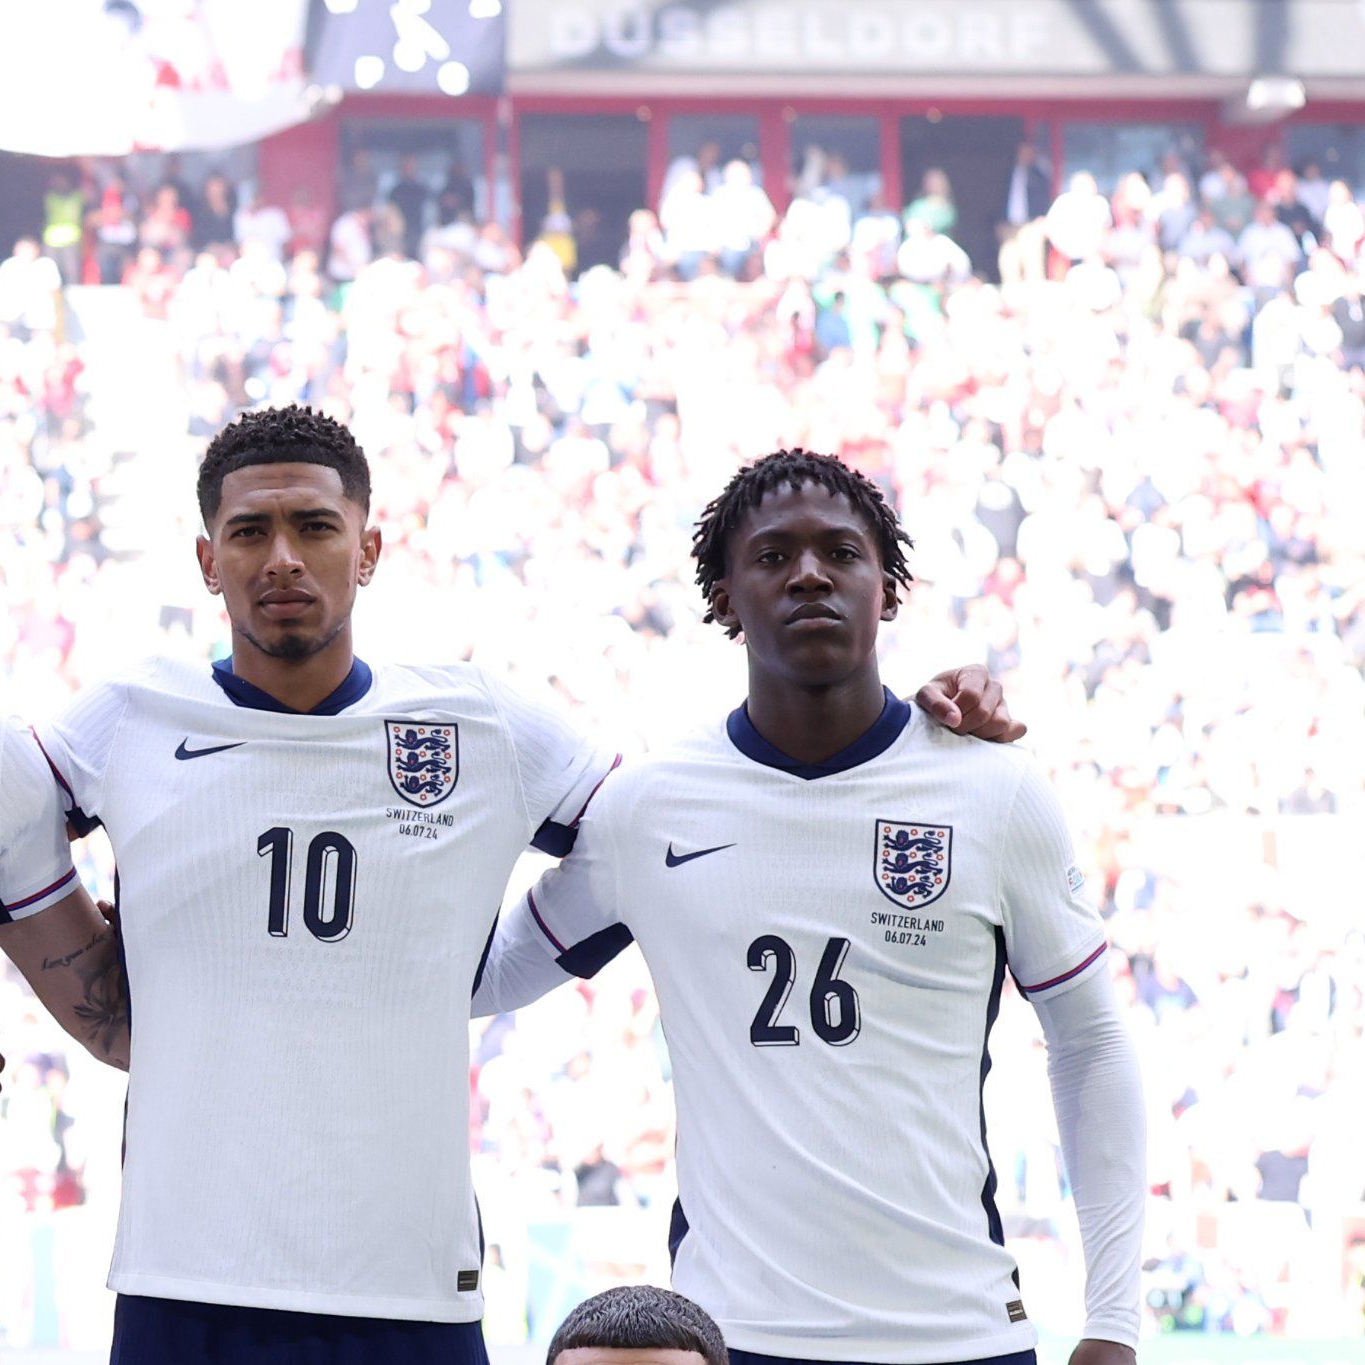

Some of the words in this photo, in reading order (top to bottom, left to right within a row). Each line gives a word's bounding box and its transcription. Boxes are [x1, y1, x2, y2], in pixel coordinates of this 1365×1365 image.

[386, 808, 454, 826] SWITZERLAND
[399, 824, 438, 840] 06.07.24
[256, 827, 358, 943] 10
[871, 912, 944, 932] SWITZERLAND
[885, 930, 926, 946] 06.07.24
[747, 934, 861, 1047] 26
